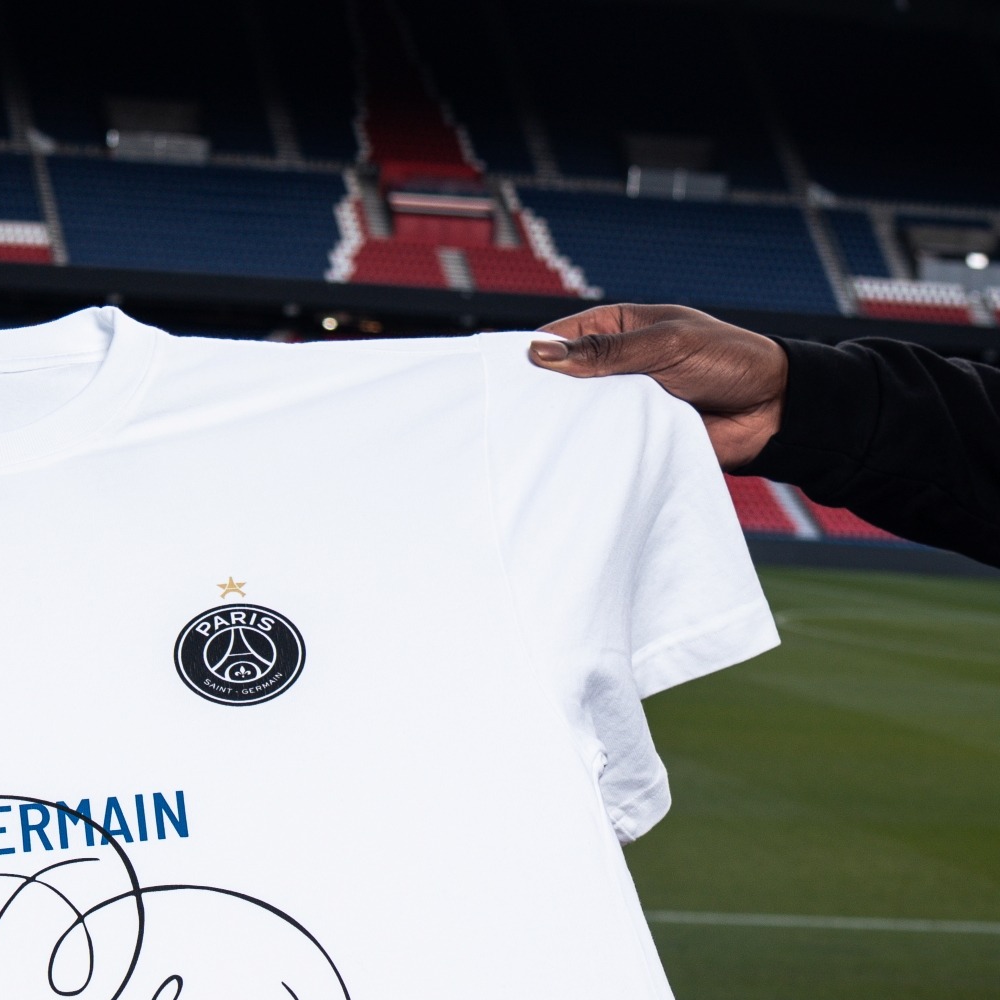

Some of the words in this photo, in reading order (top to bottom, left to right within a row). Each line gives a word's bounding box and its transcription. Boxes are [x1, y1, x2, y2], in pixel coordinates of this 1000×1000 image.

[195, 611, 276, 637] PARIS
[203, 678, 233, 695] SAINT
[241, 671, 284, 695] GERMAIN
